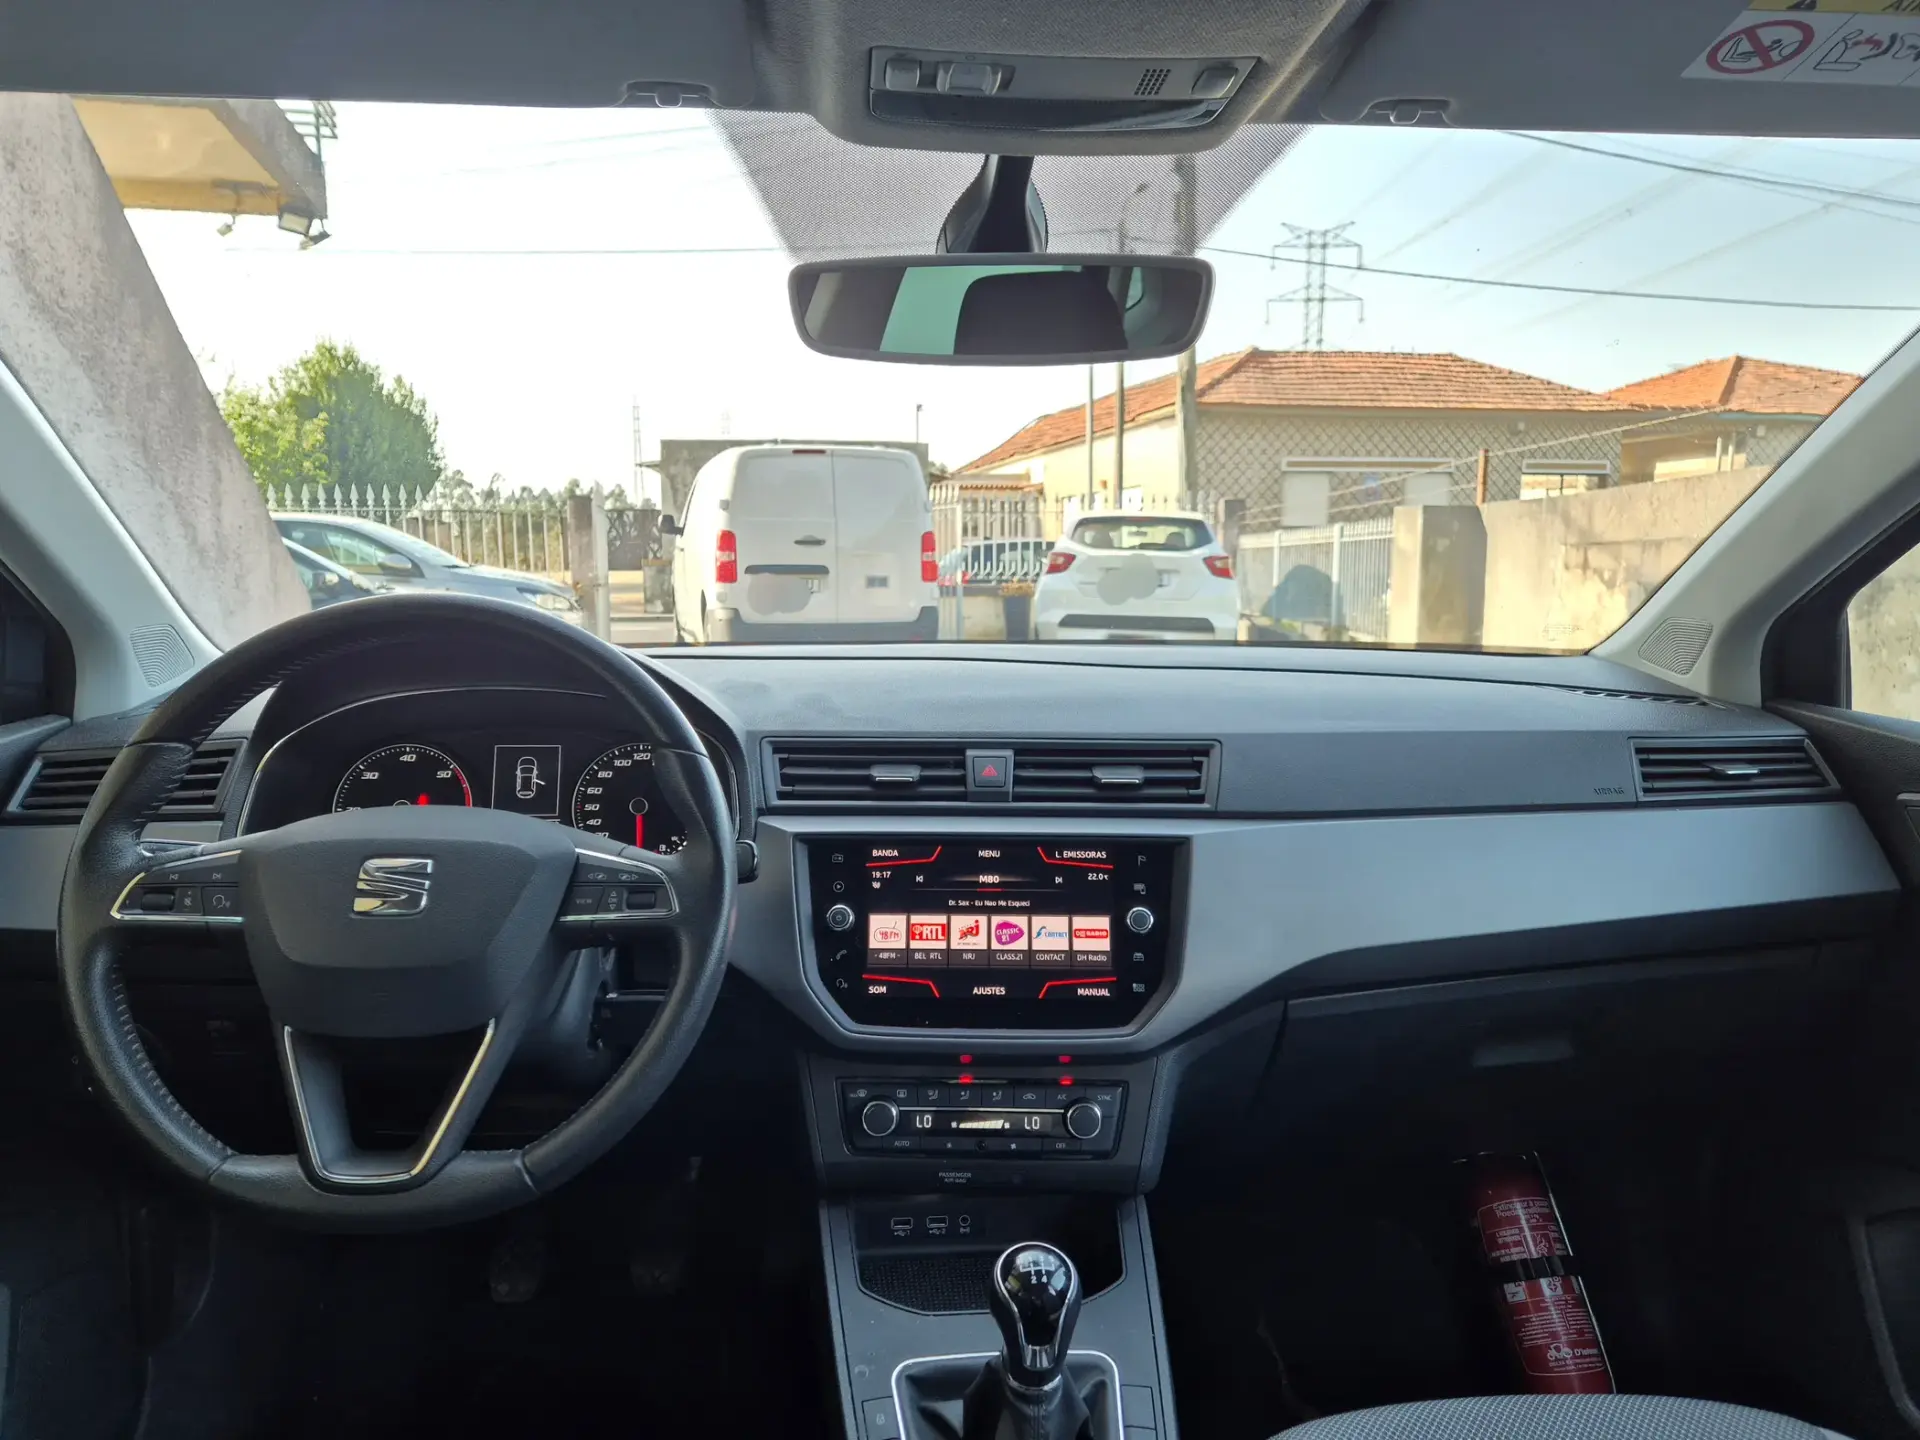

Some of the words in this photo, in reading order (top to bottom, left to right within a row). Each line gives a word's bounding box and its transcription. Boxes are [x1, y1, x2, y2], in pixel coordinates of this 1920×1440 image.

[399, 754, 416, 762] 40
[361, 771, 379, 780] 30
[587, 787, 603, 795] 60
[872, 849, 899, 857] BANDA
[978, 850, 1001, 858] MENU
[1063, 851, 1107, 859] EMISSORAS
[979, 875, 1000, 884] M80
[948, 899, 957, 907] Dr.
[923, 925, 945, 940] RTL
[996, 926, 1020, 936] CLASSIC
[1035, 953, 1065, 961] CONTACT
[1088, 954, 1107, 962] Radio
[868, 985, 887, 994] SOM
[972, 986, 1006, 996] AJUSTES
[1077, 987, 1110, 997] MANUAL
[916, 1114, 932, 1129] LO
[1024, 1116, 1040, 1130] LO
[1031, 1275, 1038, 1284] 2
[1041, 1275, 1048, 1283] 4
